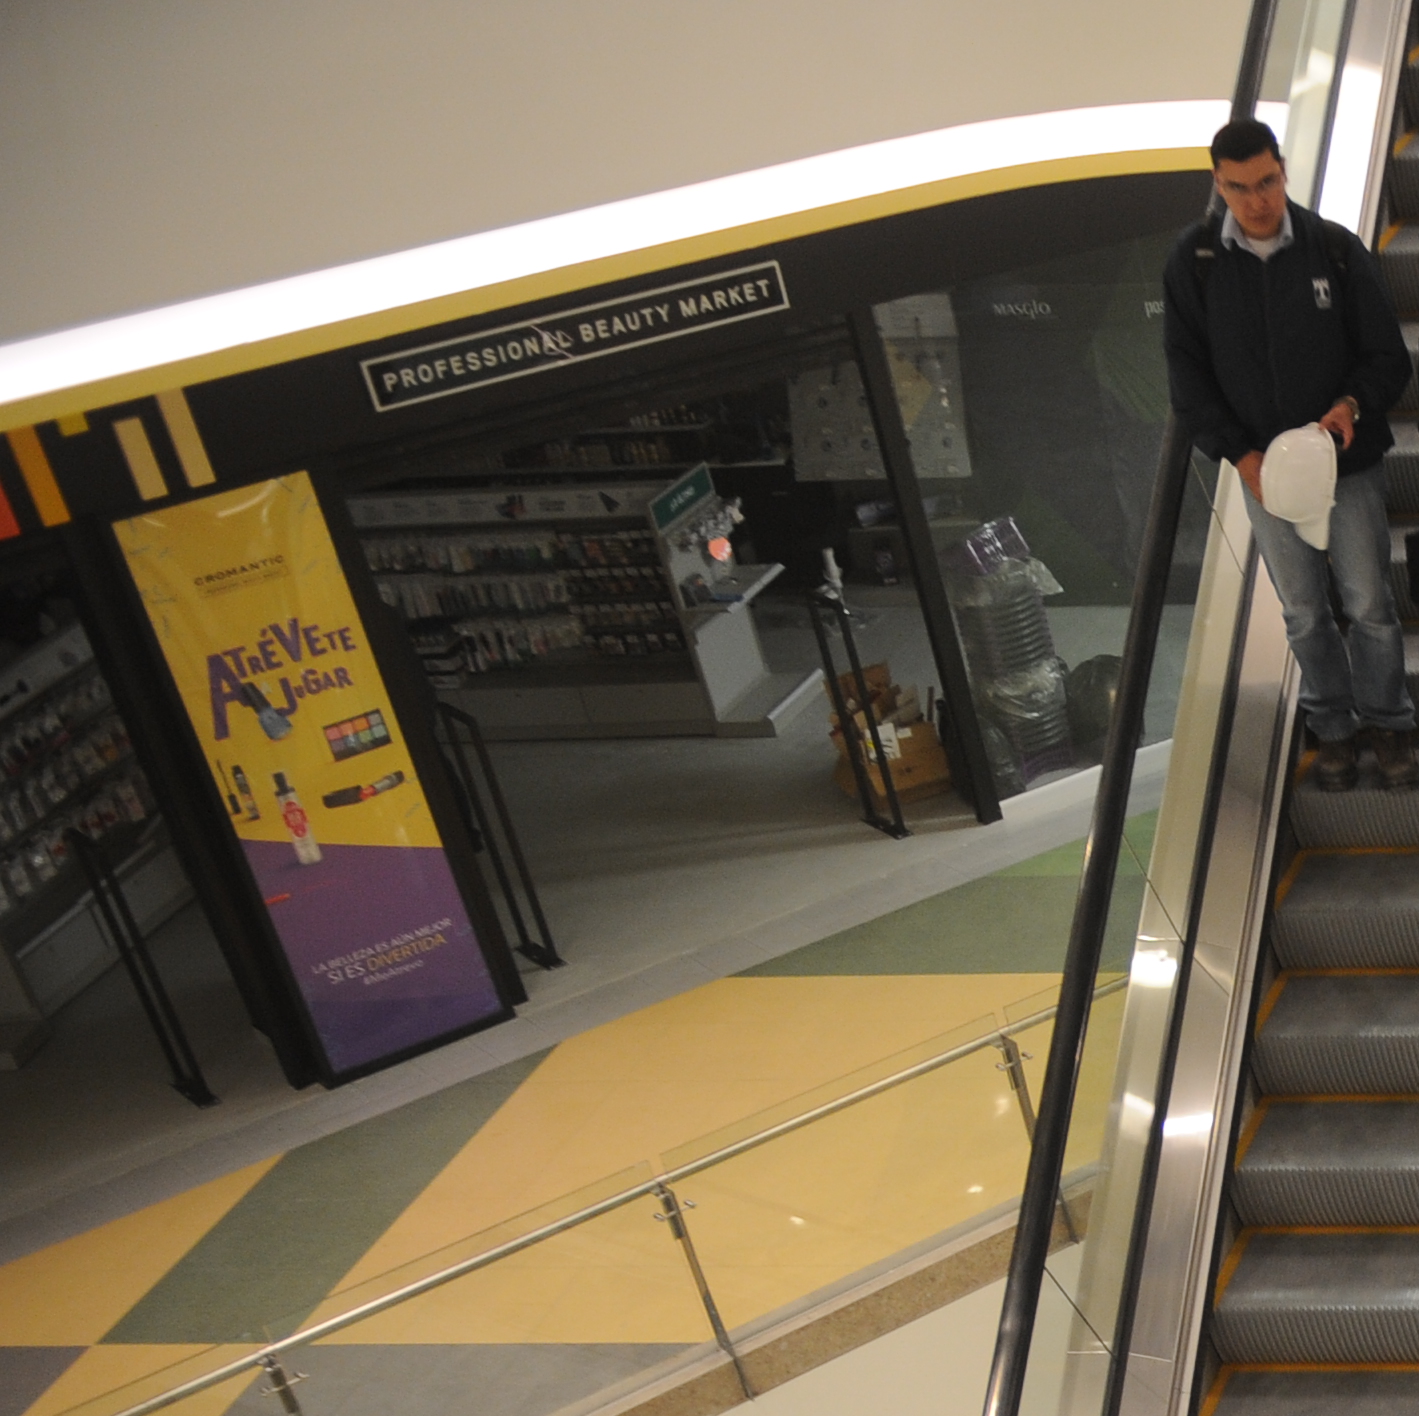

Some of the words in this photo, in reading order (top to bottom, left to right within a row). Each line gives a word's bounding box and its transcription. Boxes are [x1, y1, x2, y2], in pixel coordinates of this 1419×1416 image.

[381, 328, 571, 393] PROFESSIONAL
[579, 304, 671, 343] BEAUTY
[680, 278, 771, 318] MARKET
[206, 617, 357, 742] ATRÉVETE
[345, 963, 366, 979] ES
[366, 932, 448, 972] DIVERTIDA
